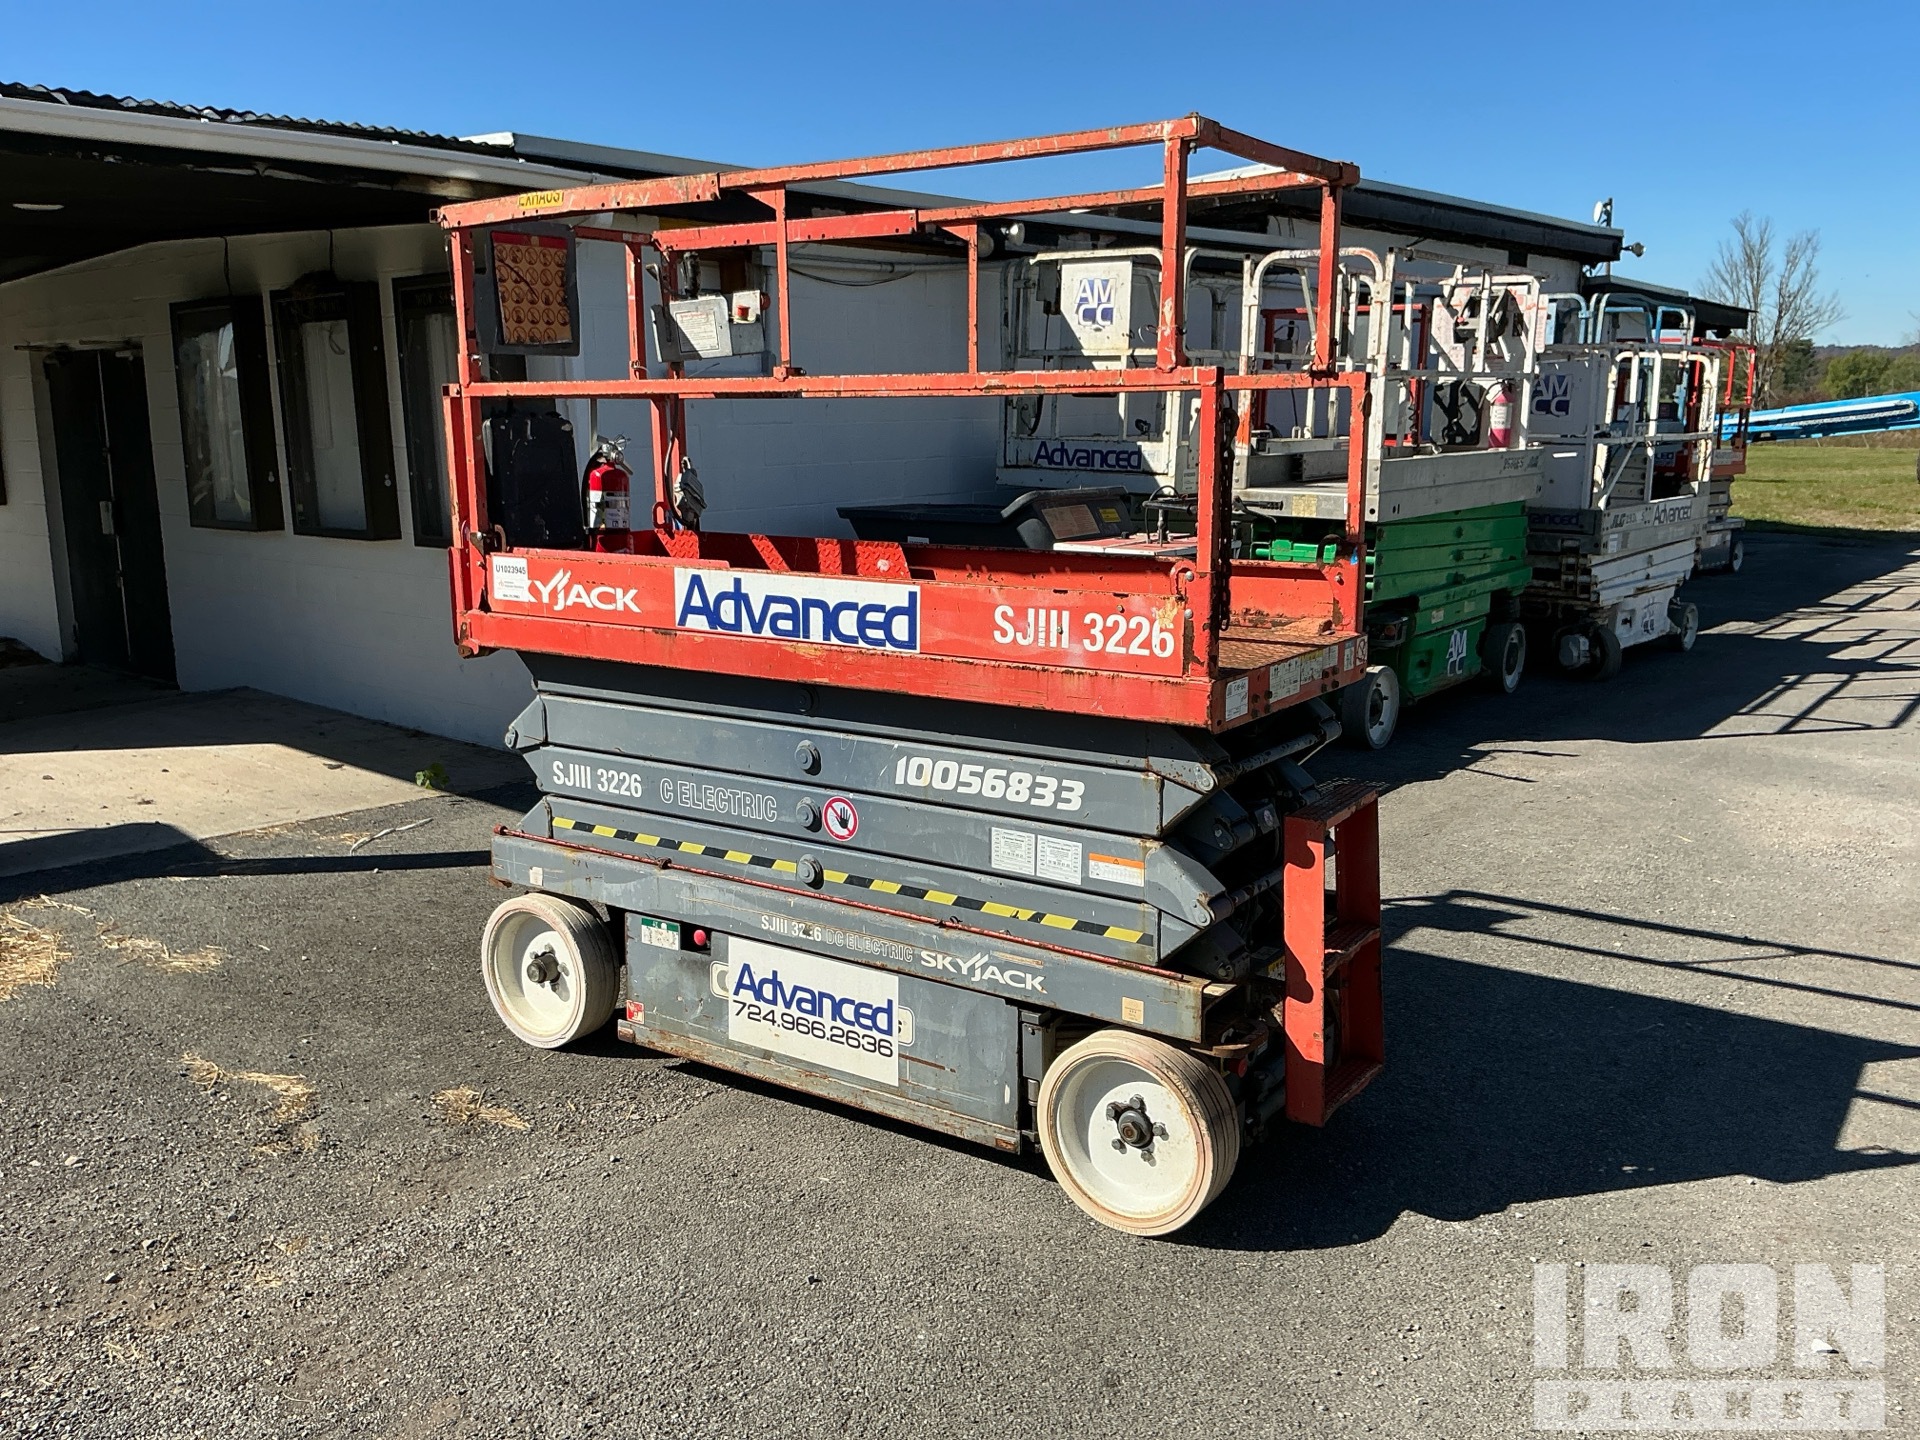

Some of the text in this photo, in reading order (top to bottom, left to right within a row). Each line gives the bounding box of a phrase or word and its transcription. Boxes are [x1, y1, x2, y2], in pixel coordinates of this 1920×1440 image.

[1034, 441, 1142, 470] Advanced
[1653, 501, 1693, 526] Advanced
[495, 564, 527, 575] U1023945
[677, 574, 918, 651] Advanced
[1082, 612, 1175, 658] 3226
[596, 768, 643, 798] 3226
[659, 777, 674, 804] C
[677, 780, 778, 823] ELECTRIC
[895, 755, 1086, 812] 10056833
[826, 928, 845, 948] DC
[846, 931, 914, 963] ELECTRIC
[920, 952, 1049, 994] SKYJACK
[733, 963, 894, 1037] Advanced
[733, 1000, 894, 1058] 724.966.2636
